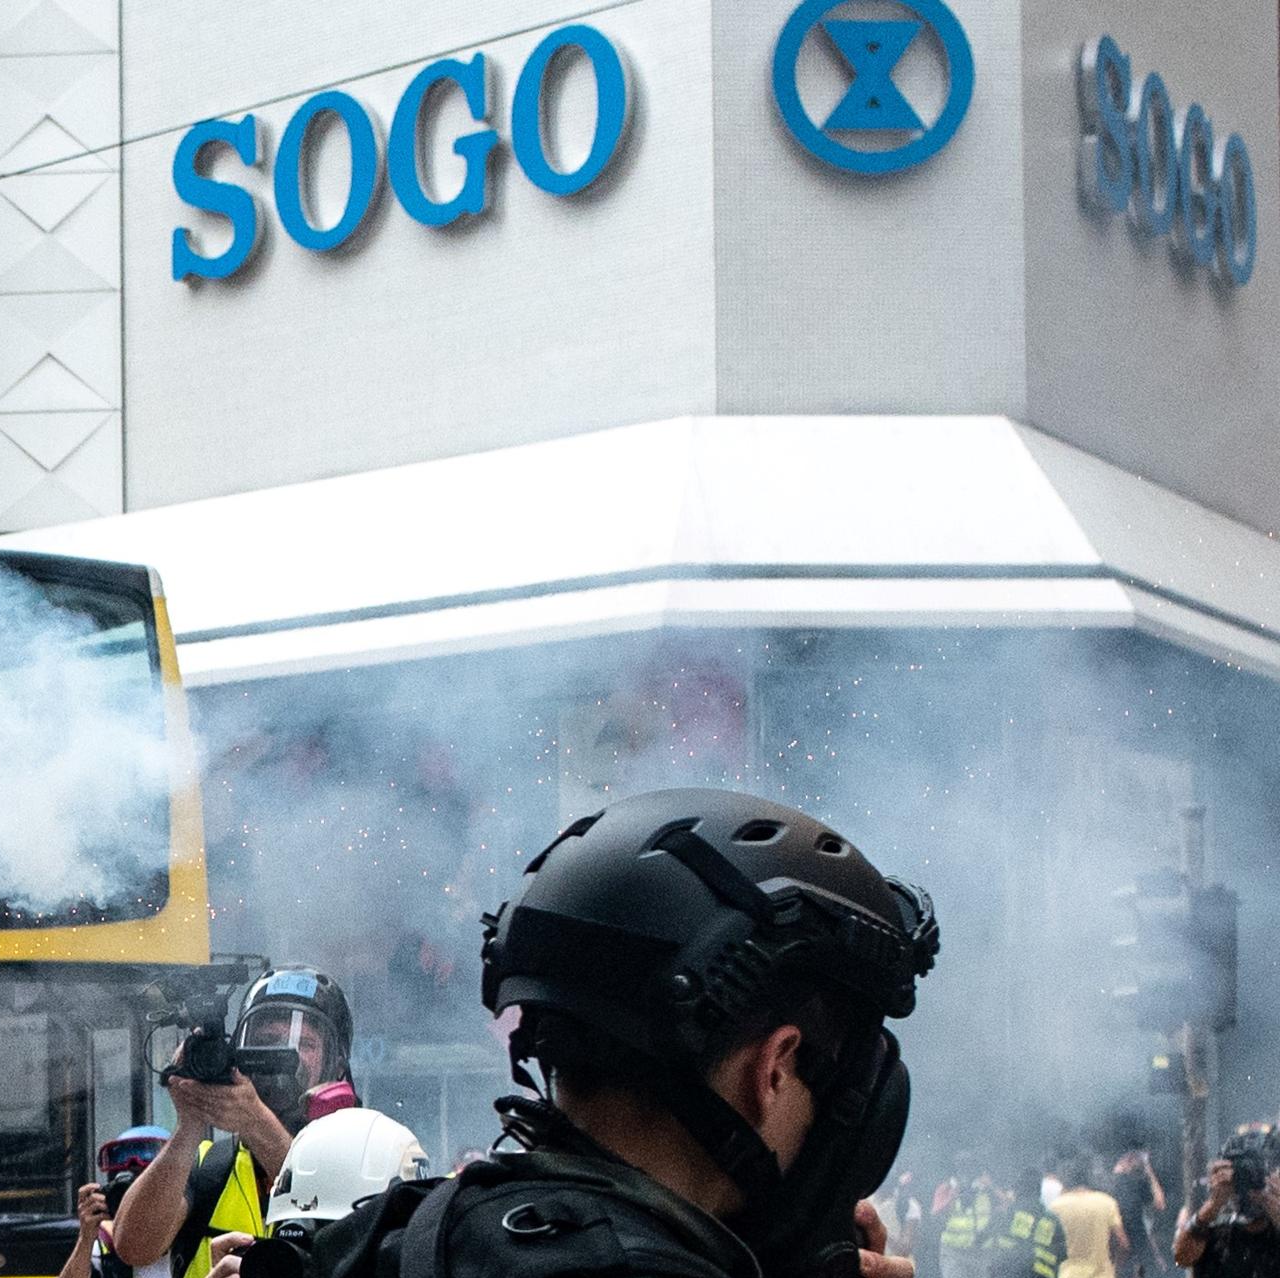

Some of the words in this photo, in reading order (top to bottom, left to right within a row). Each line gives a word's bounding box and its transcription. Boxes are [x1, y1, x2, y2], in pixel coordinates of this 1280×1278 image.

[172, 24, 628, 281] SOGO
[1080, 33, 1257, 287] SOGO
[279, 1229, 304, 1238] Nikon
